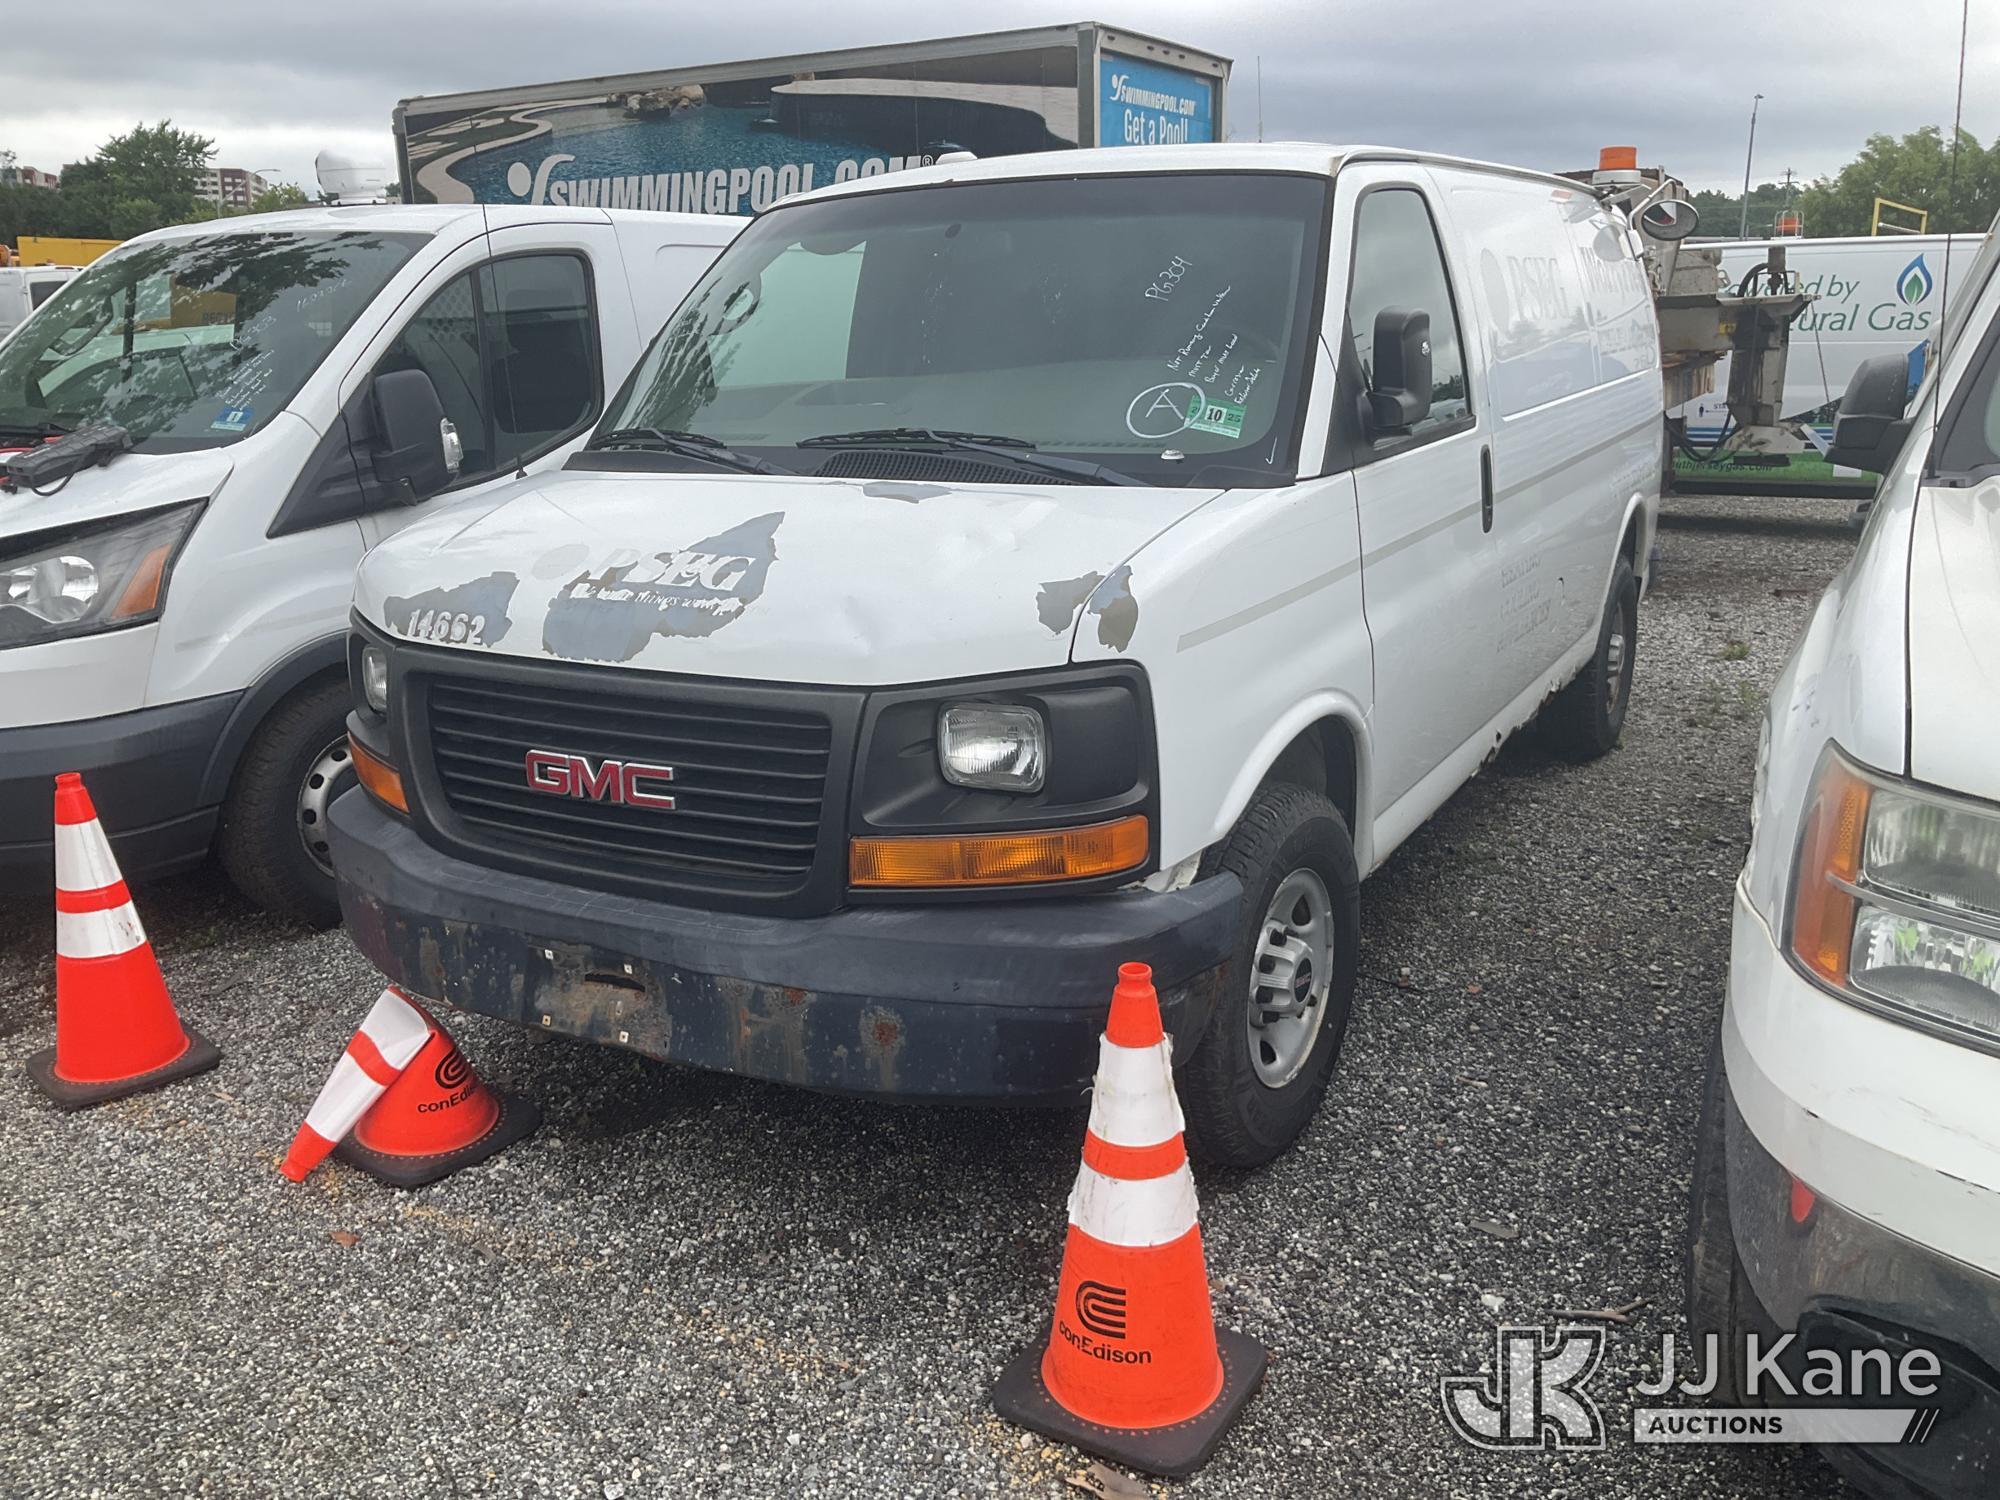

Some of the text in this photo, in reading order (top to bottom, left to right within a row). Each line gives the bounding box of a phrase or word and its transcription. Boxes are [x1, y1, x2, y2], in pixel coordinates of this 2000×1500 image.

[1124, 108, 1145, 146] Get
[1148, 119, 1156, 146] a
[1826, 274, 1860, 304] by
[1867, 302, 1932, 331] Gas
[1145, 388, 1185, 420] A
[1207, 407, 1223, 422] 10
[407, 608, 486, 645] 14662
[525, 749, 676, 810] GMC
[1058, 1320, 1152, 1364] conEdison
